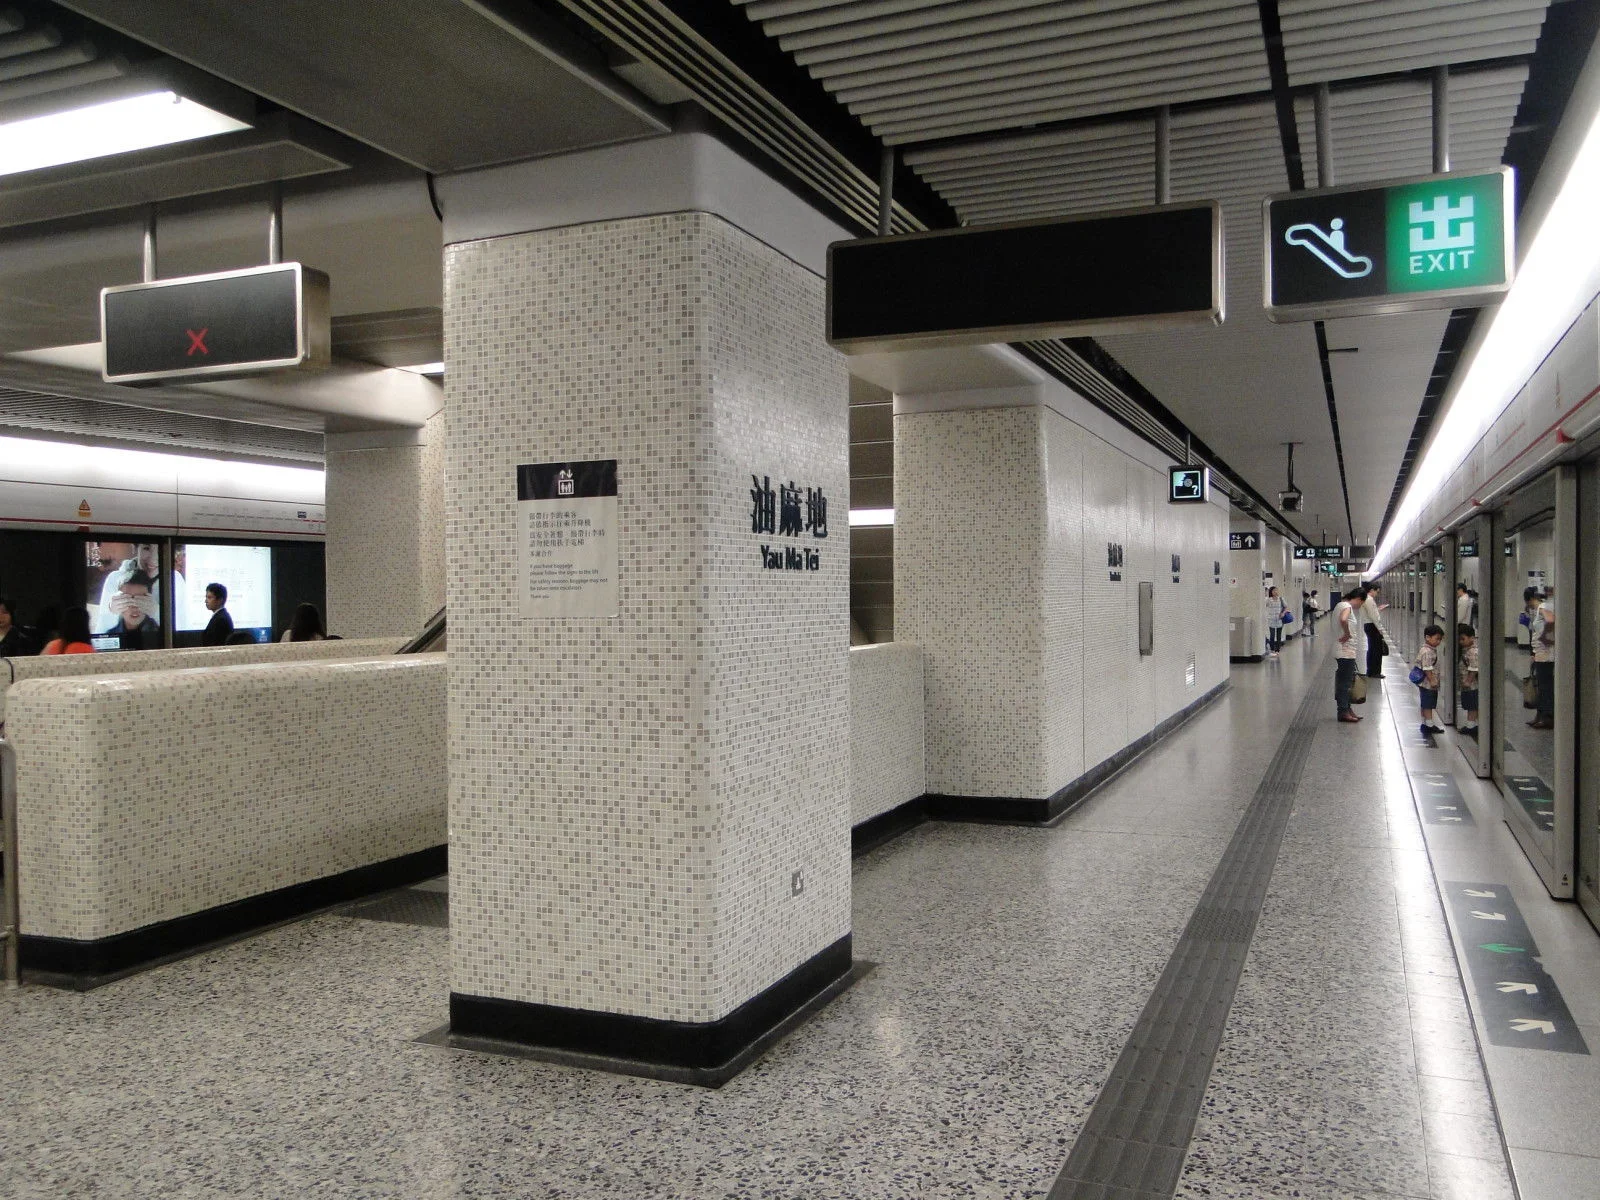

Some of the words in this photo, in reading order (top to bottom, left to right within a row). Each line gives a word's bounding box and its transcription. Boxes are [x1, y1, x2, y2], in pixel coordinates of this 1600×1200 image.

[1409, 196, 1474, 252] 出
[1409, 250, 1474, 274] EXIT
[761, 545, 783, 569] Yau
[785, 547, 803, 570] Ma
[804, 548, 819, 570] Tei
